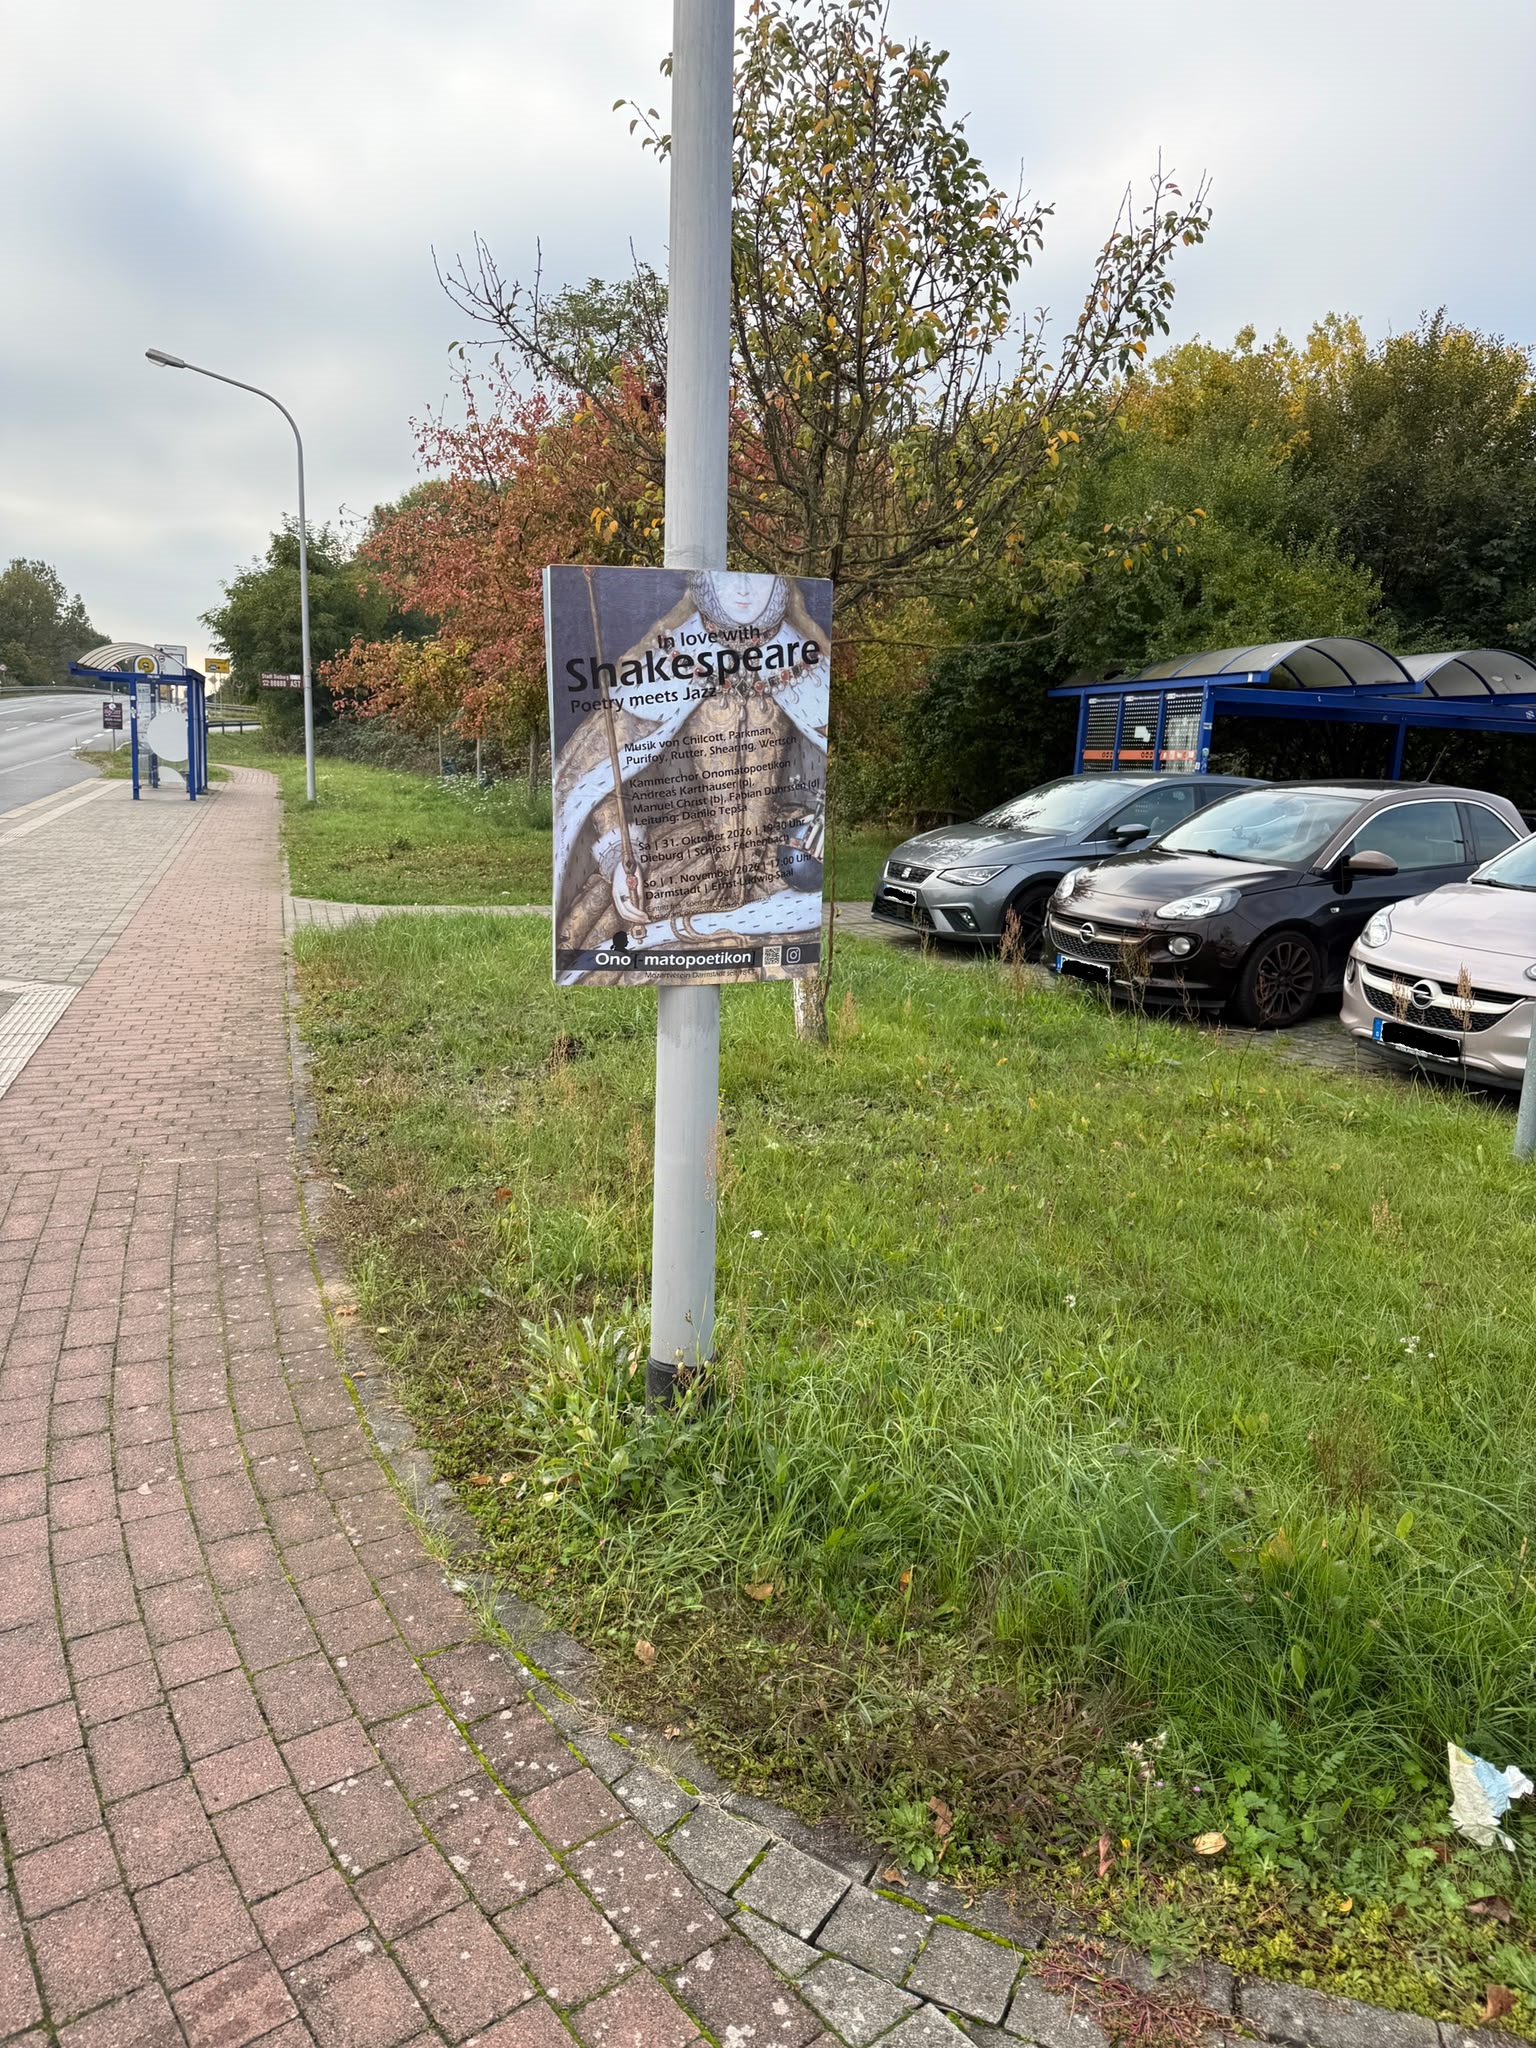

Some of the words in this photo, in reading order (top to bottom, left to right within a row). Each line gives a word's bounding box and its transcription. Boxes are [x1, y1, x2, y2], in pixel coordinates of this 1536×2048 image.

[657, 634, 675, 650] In
[680, 630, 718, 648] love
[722, 625, 760, 643] with
[565, 638, 820, 693] Shakespeare
[571, 697, 624, 713] Poetry
[629, 689, 678, 706] meets
[682, 685, 717, 702] Jazz
[624, 743, 657, 753] Musik
[659, 740, 679, 749] von
[629, 772, 700, 788] Kammerchor
[702, 760, 791, 779] Onomatopoetikon
[632, 786, 677, 801] Andreas
[633, 800, 674, 814] Manuel
[677, 796, 708, 809] Christ
[729, 789, 762, 802] Fabian
[635, 813, 680, 827] Leitung:
[682, 808, 716, 821] Danilo
[638, 842, 651, 852] Sa
[662, 836, 680, 848] 31.
[682, 831, 725, 846] Oktober
[727, 826, 752, 838] 2026
[640, 851, 684, 864] Dieburg
[694, 843, 731, 857] Schloss
[733, 832, 790, 849] Fechenbach
[643, 879, 657, 889] So
[680, 868, 734, 883] November
[736, 862, 760, 875] 2026
[796, 854, 812, 865] Uhr
[645, 884, 701, 901] Darmstadt
[595, 952, 632, 966] Ono
